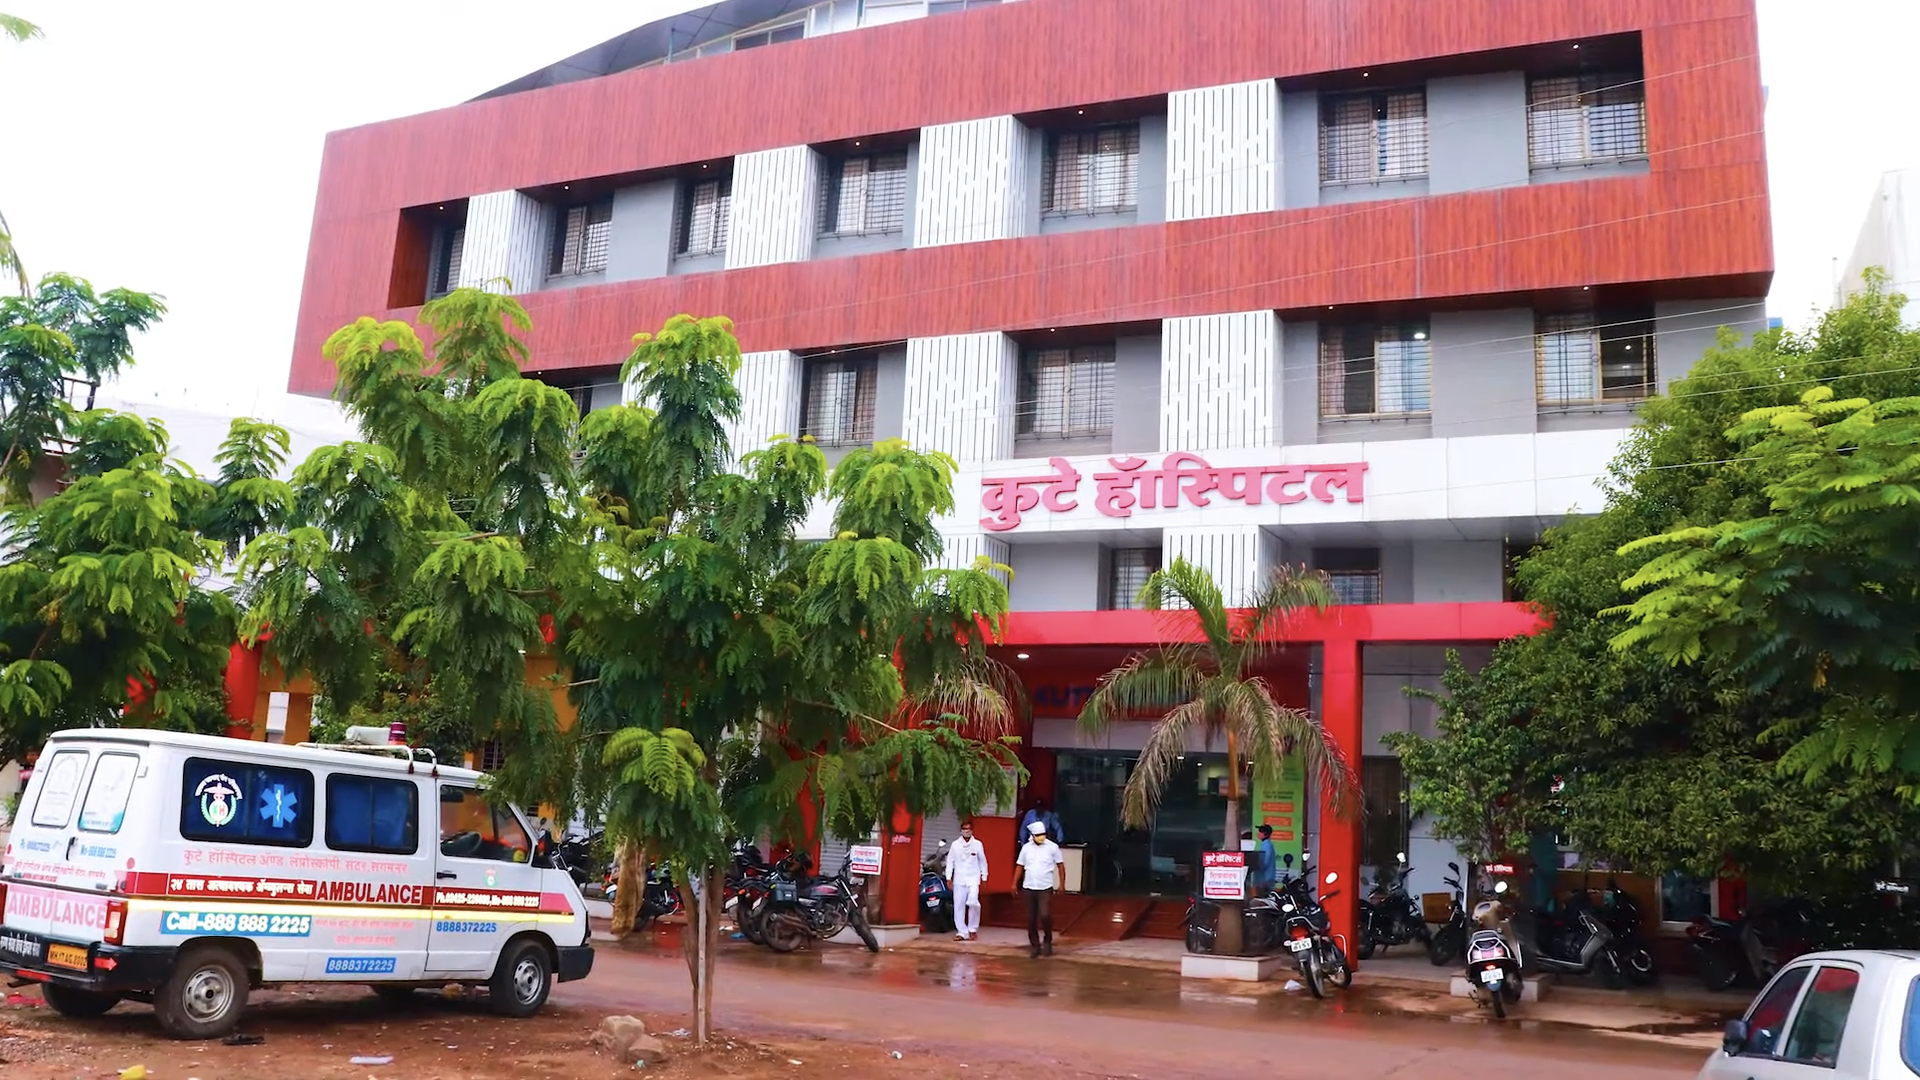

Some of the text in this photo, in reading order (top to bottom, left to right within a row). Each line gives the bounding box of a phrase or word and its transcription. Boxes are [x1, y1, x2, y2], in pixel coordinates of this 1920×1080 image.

[980, 452, 1370, 532] कुटे हॉस्पिटल
[317, 880, 421, 904] AMBULANCE
[7, 892, 106, 930] AMBULANCE
[237, 914, 269, 933] 888
[269, 915, 310, 934] 2225
[436, 921, 497, 933] 8888372225
[328, 959, 393, 971] 8888372225
